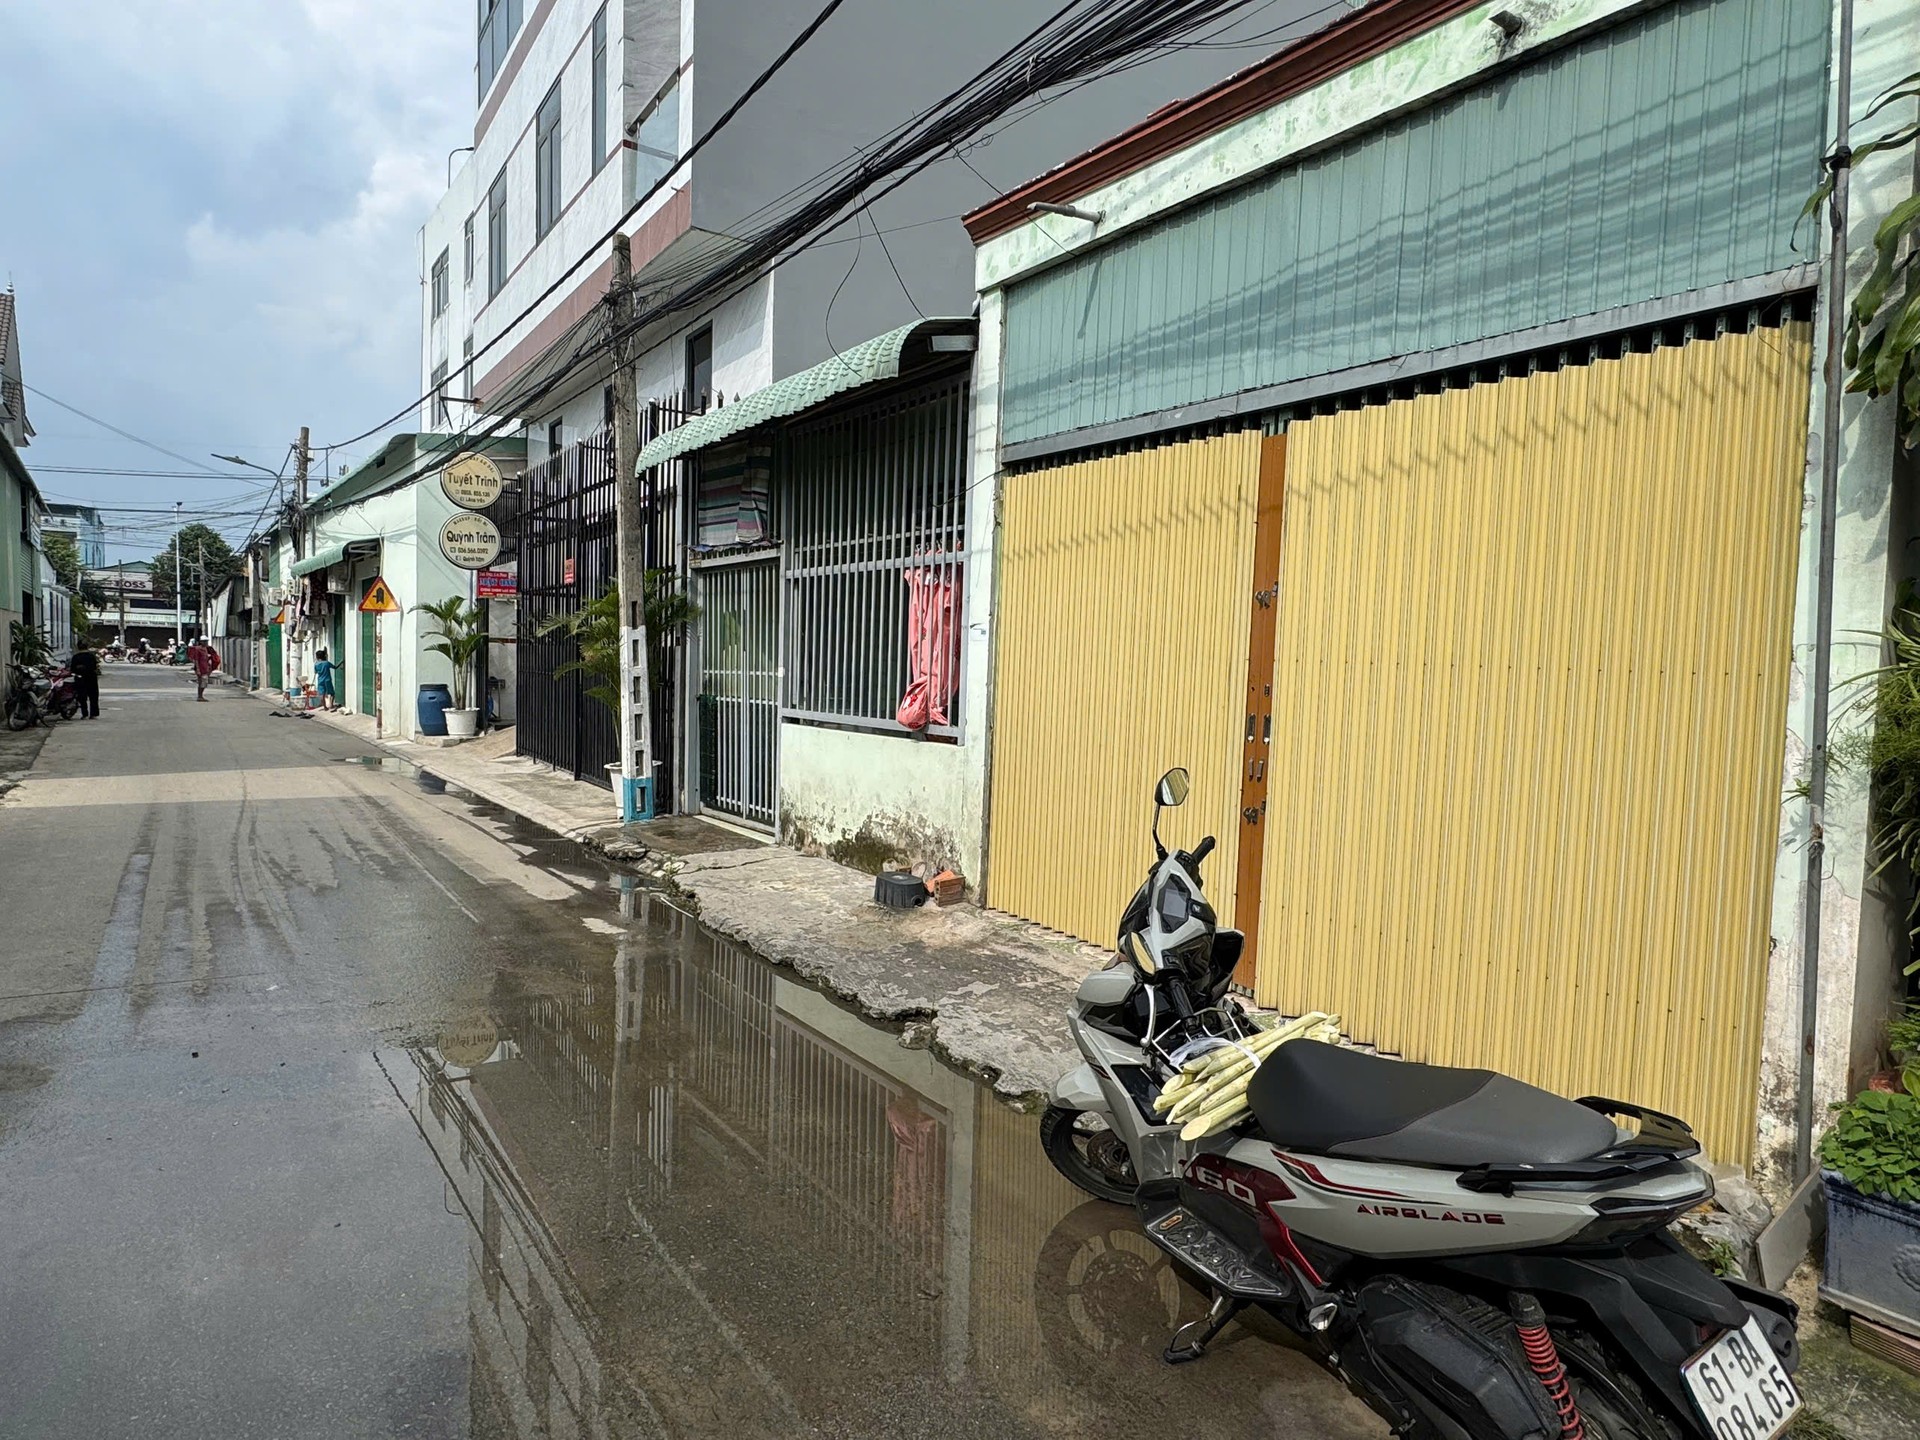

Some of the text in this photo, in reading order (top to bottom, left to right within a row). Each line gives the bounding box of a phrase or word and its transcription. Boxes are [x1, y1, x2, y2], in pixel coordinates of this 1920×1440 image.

[447, 472, 498, 488] Tuyết Trinh
[446, 530, 474, 545] Quỳnh
[1357, 1203, 1506, 1226] AIRBLADE
